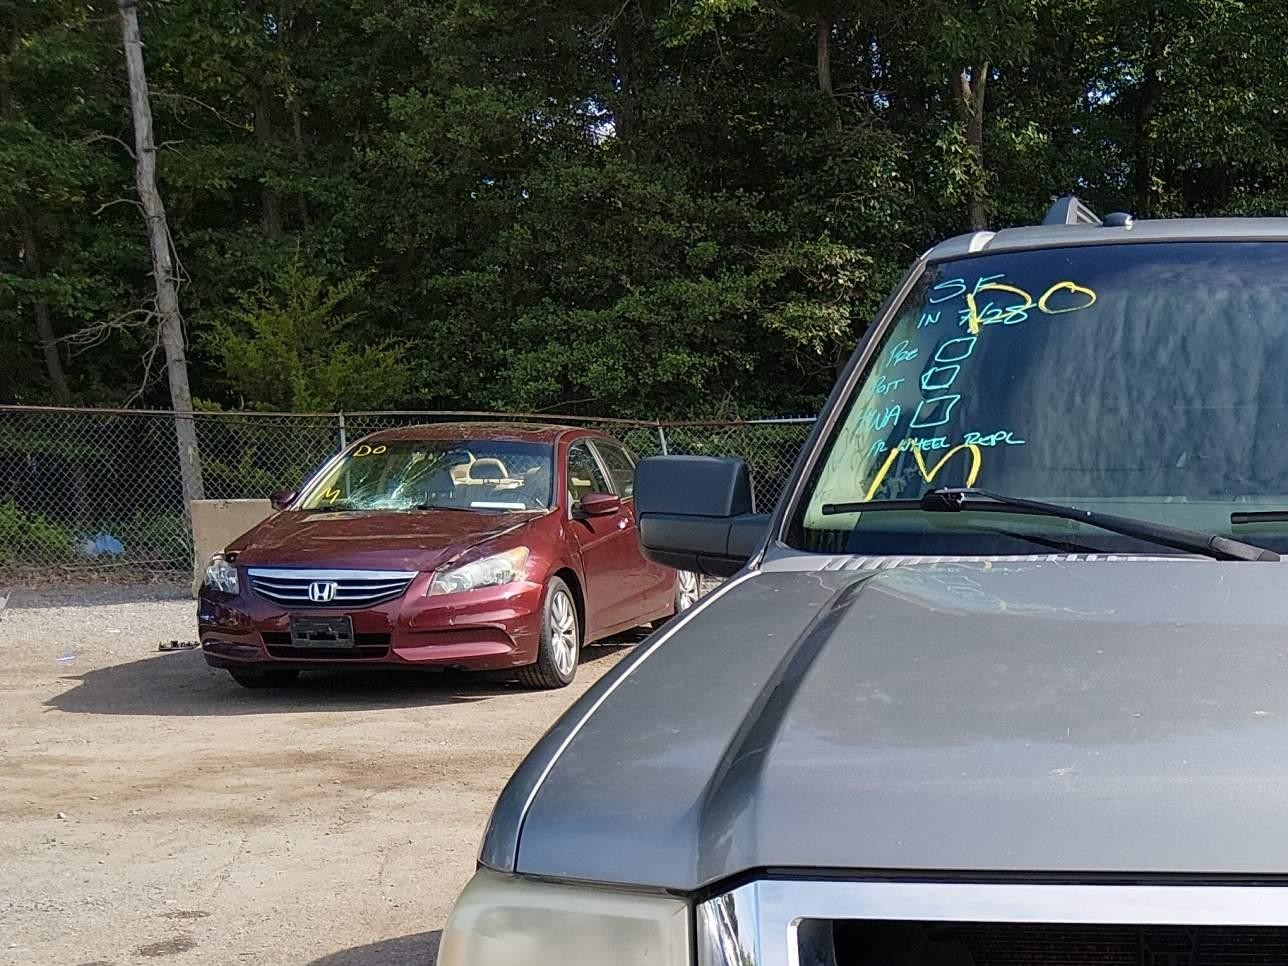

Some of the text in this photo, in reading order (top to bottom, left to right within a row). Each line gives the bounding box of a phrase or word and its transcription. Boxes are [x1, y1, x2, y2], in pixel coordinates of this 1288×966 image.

[917, 311, 942, 329] IN
[898, 436, 950, 452] WHEEL
[964, 431, 1026, 447] REPL
[353, 445, 386, 457] DO
